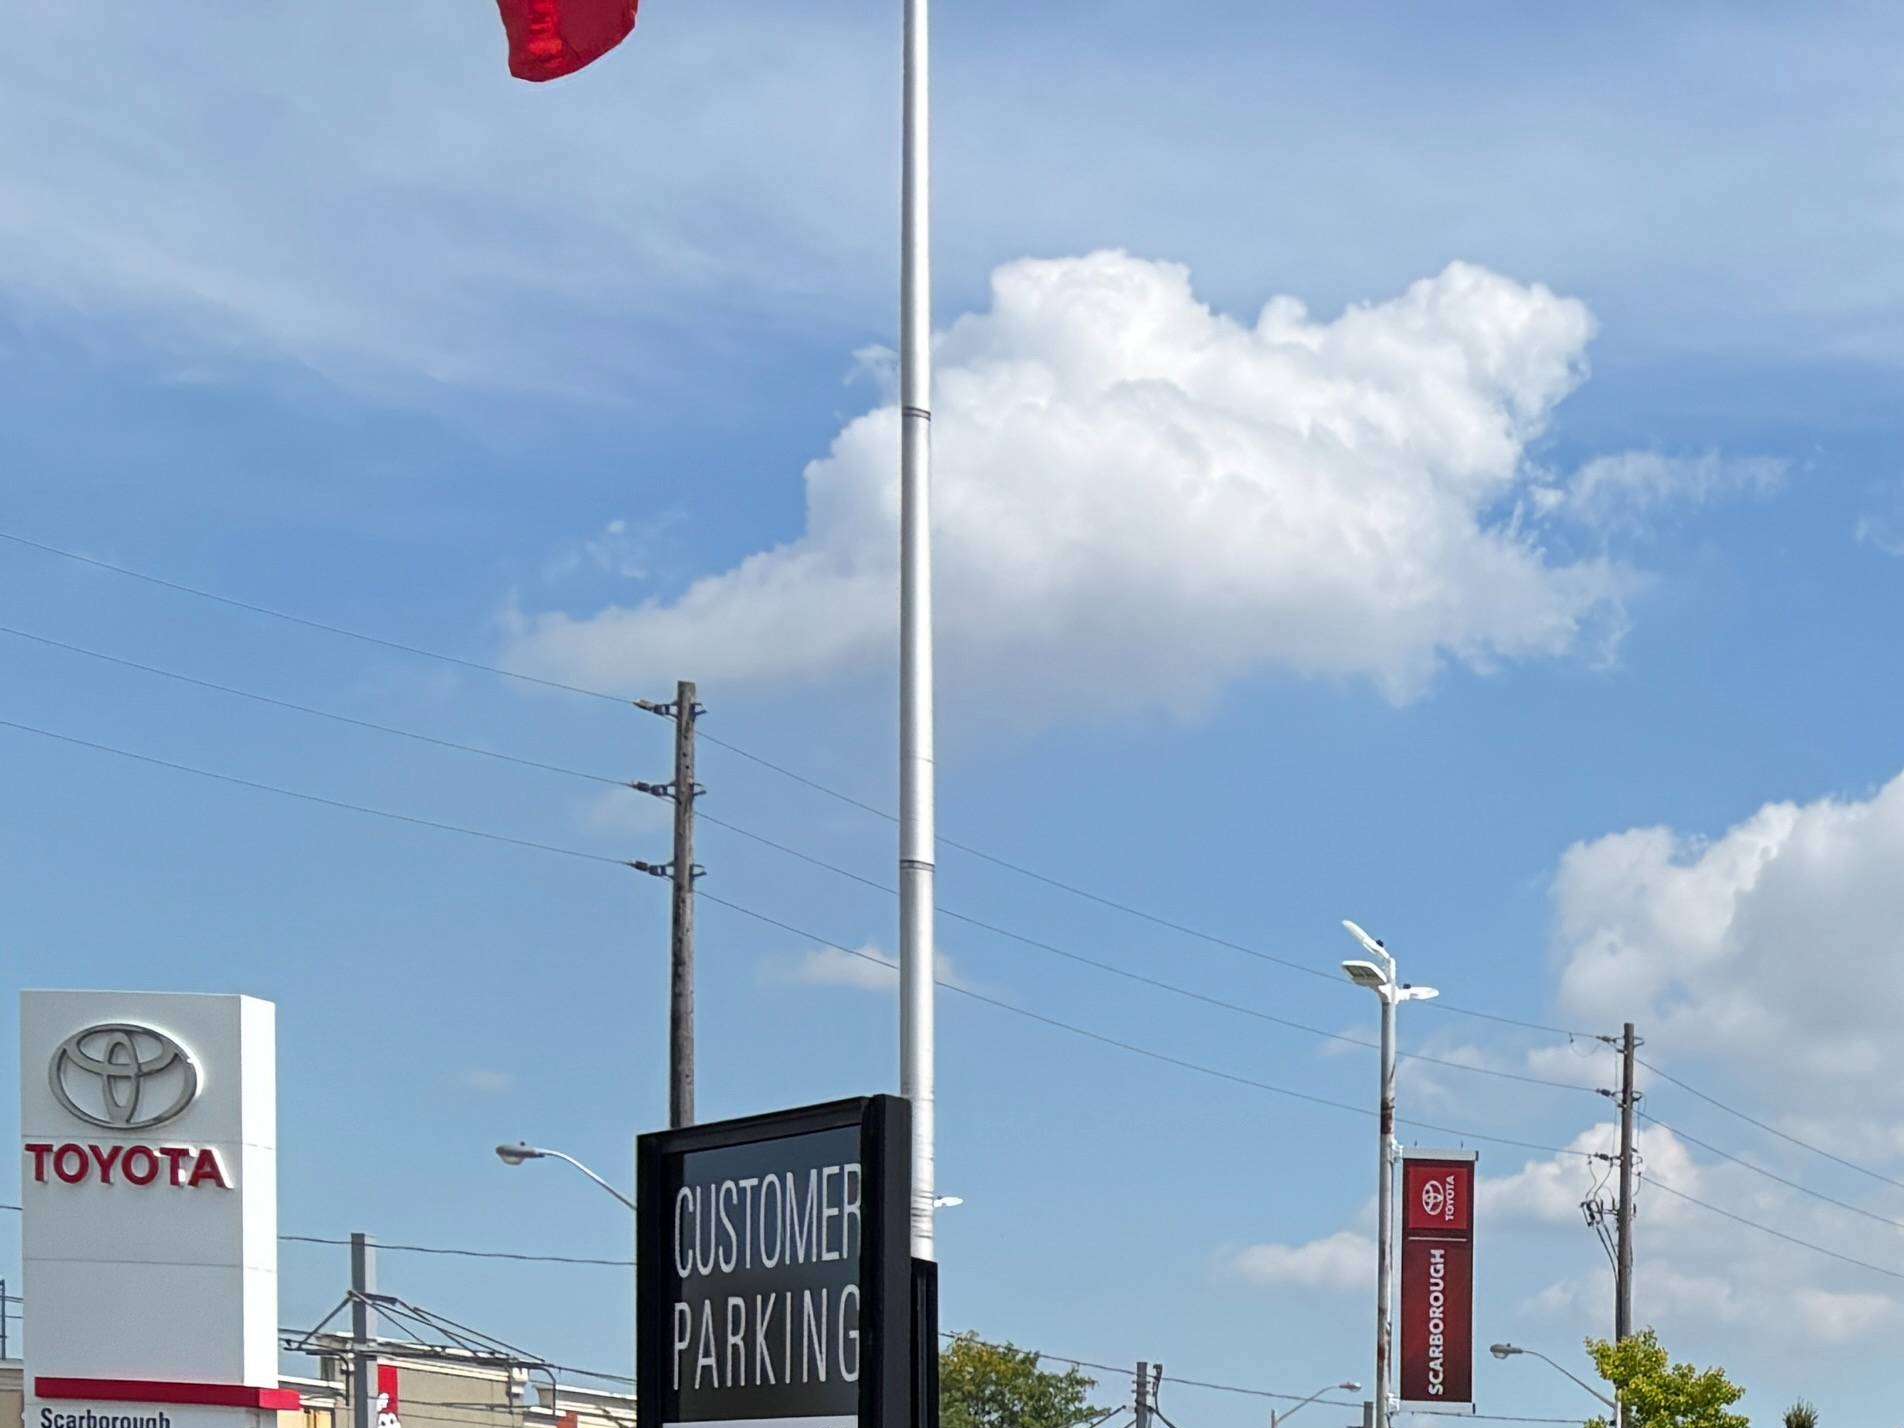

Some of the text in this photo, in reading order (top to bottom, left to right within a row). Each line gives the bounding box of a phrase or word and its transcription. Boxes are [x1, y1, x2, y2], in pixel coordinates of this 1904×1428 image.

[25, 1143, 232, 1190] TOYOTA
[1445, 1176, 1455, 1221] TOYOTA
[675, 1163, 861, 1278] CUSTOMER
[674, 1284, 860, 1390] PARKING
[1429, 1249, 1445, 1395] SCARBOROUGH
